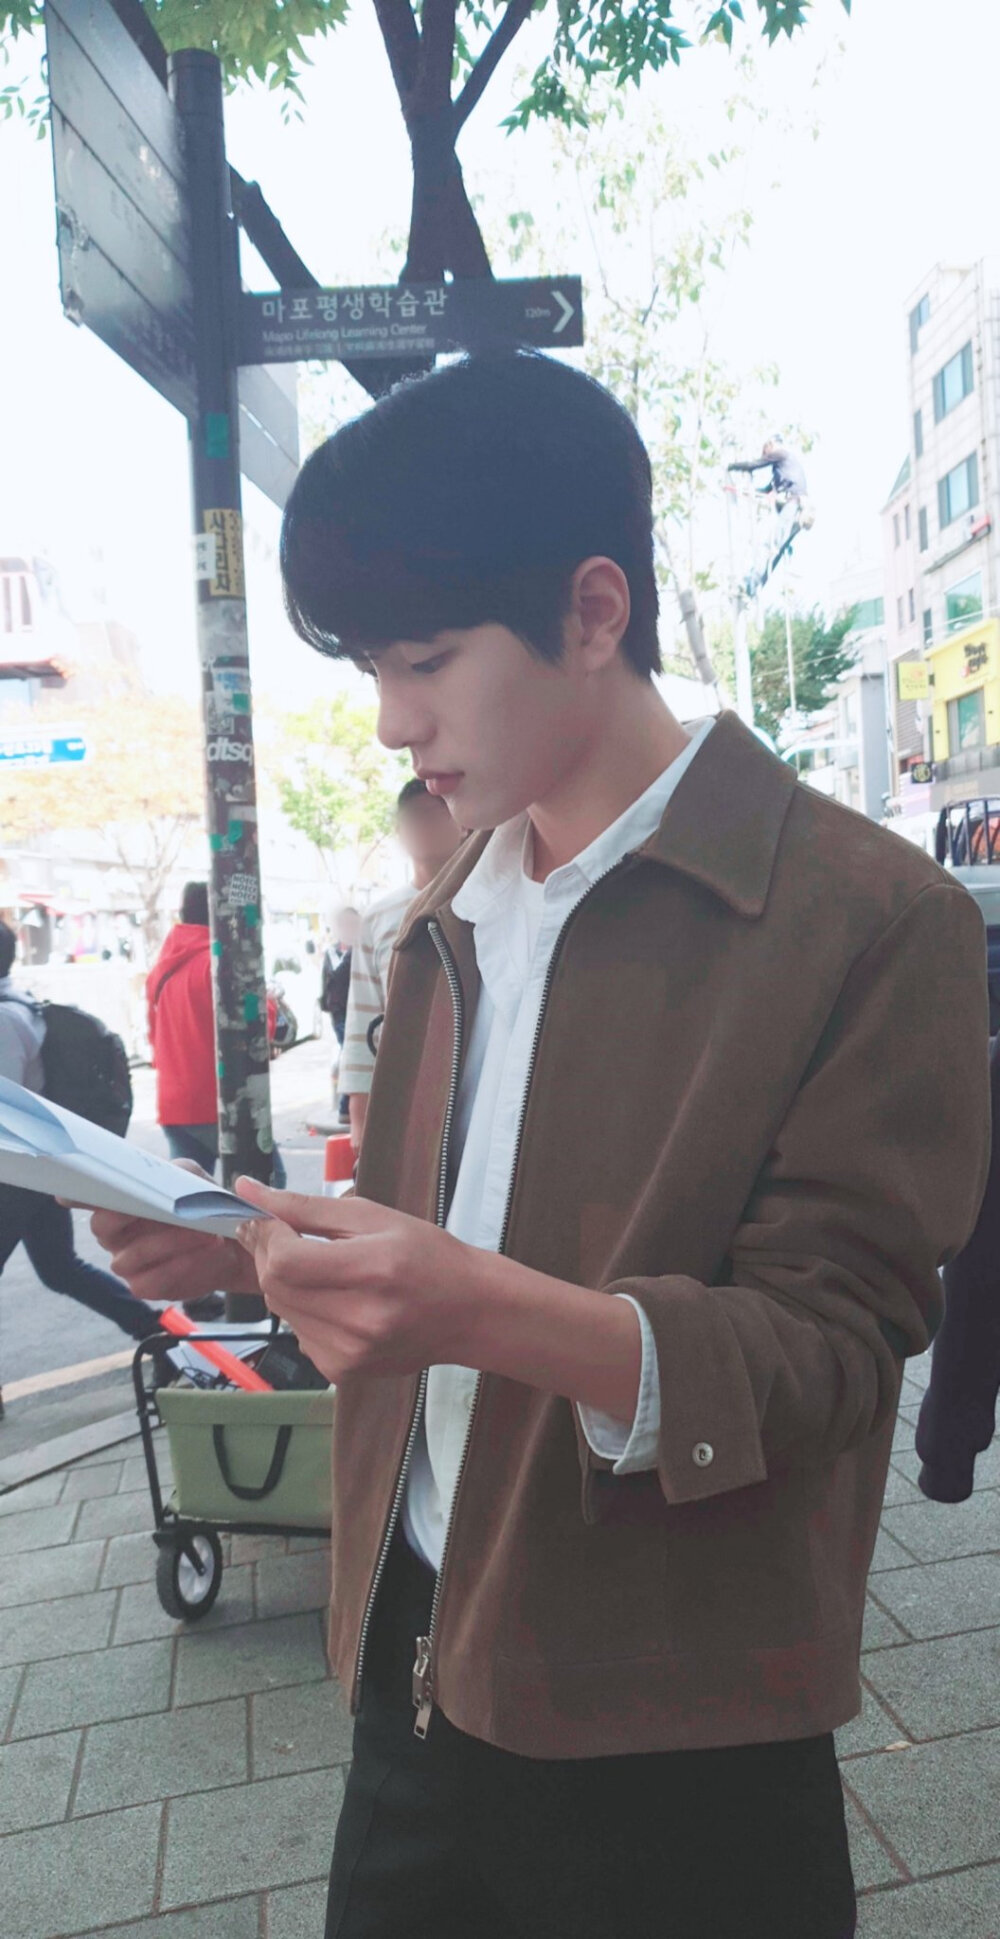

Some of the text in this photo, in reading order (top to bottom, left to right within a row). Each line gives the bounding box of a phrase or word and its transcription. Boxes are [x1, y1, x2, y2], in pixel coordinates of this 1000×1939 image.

[262, 288, 448, 323] 마포평생학습관
[263, 323, 428, 343] Mapo Lifelong Learning Center
